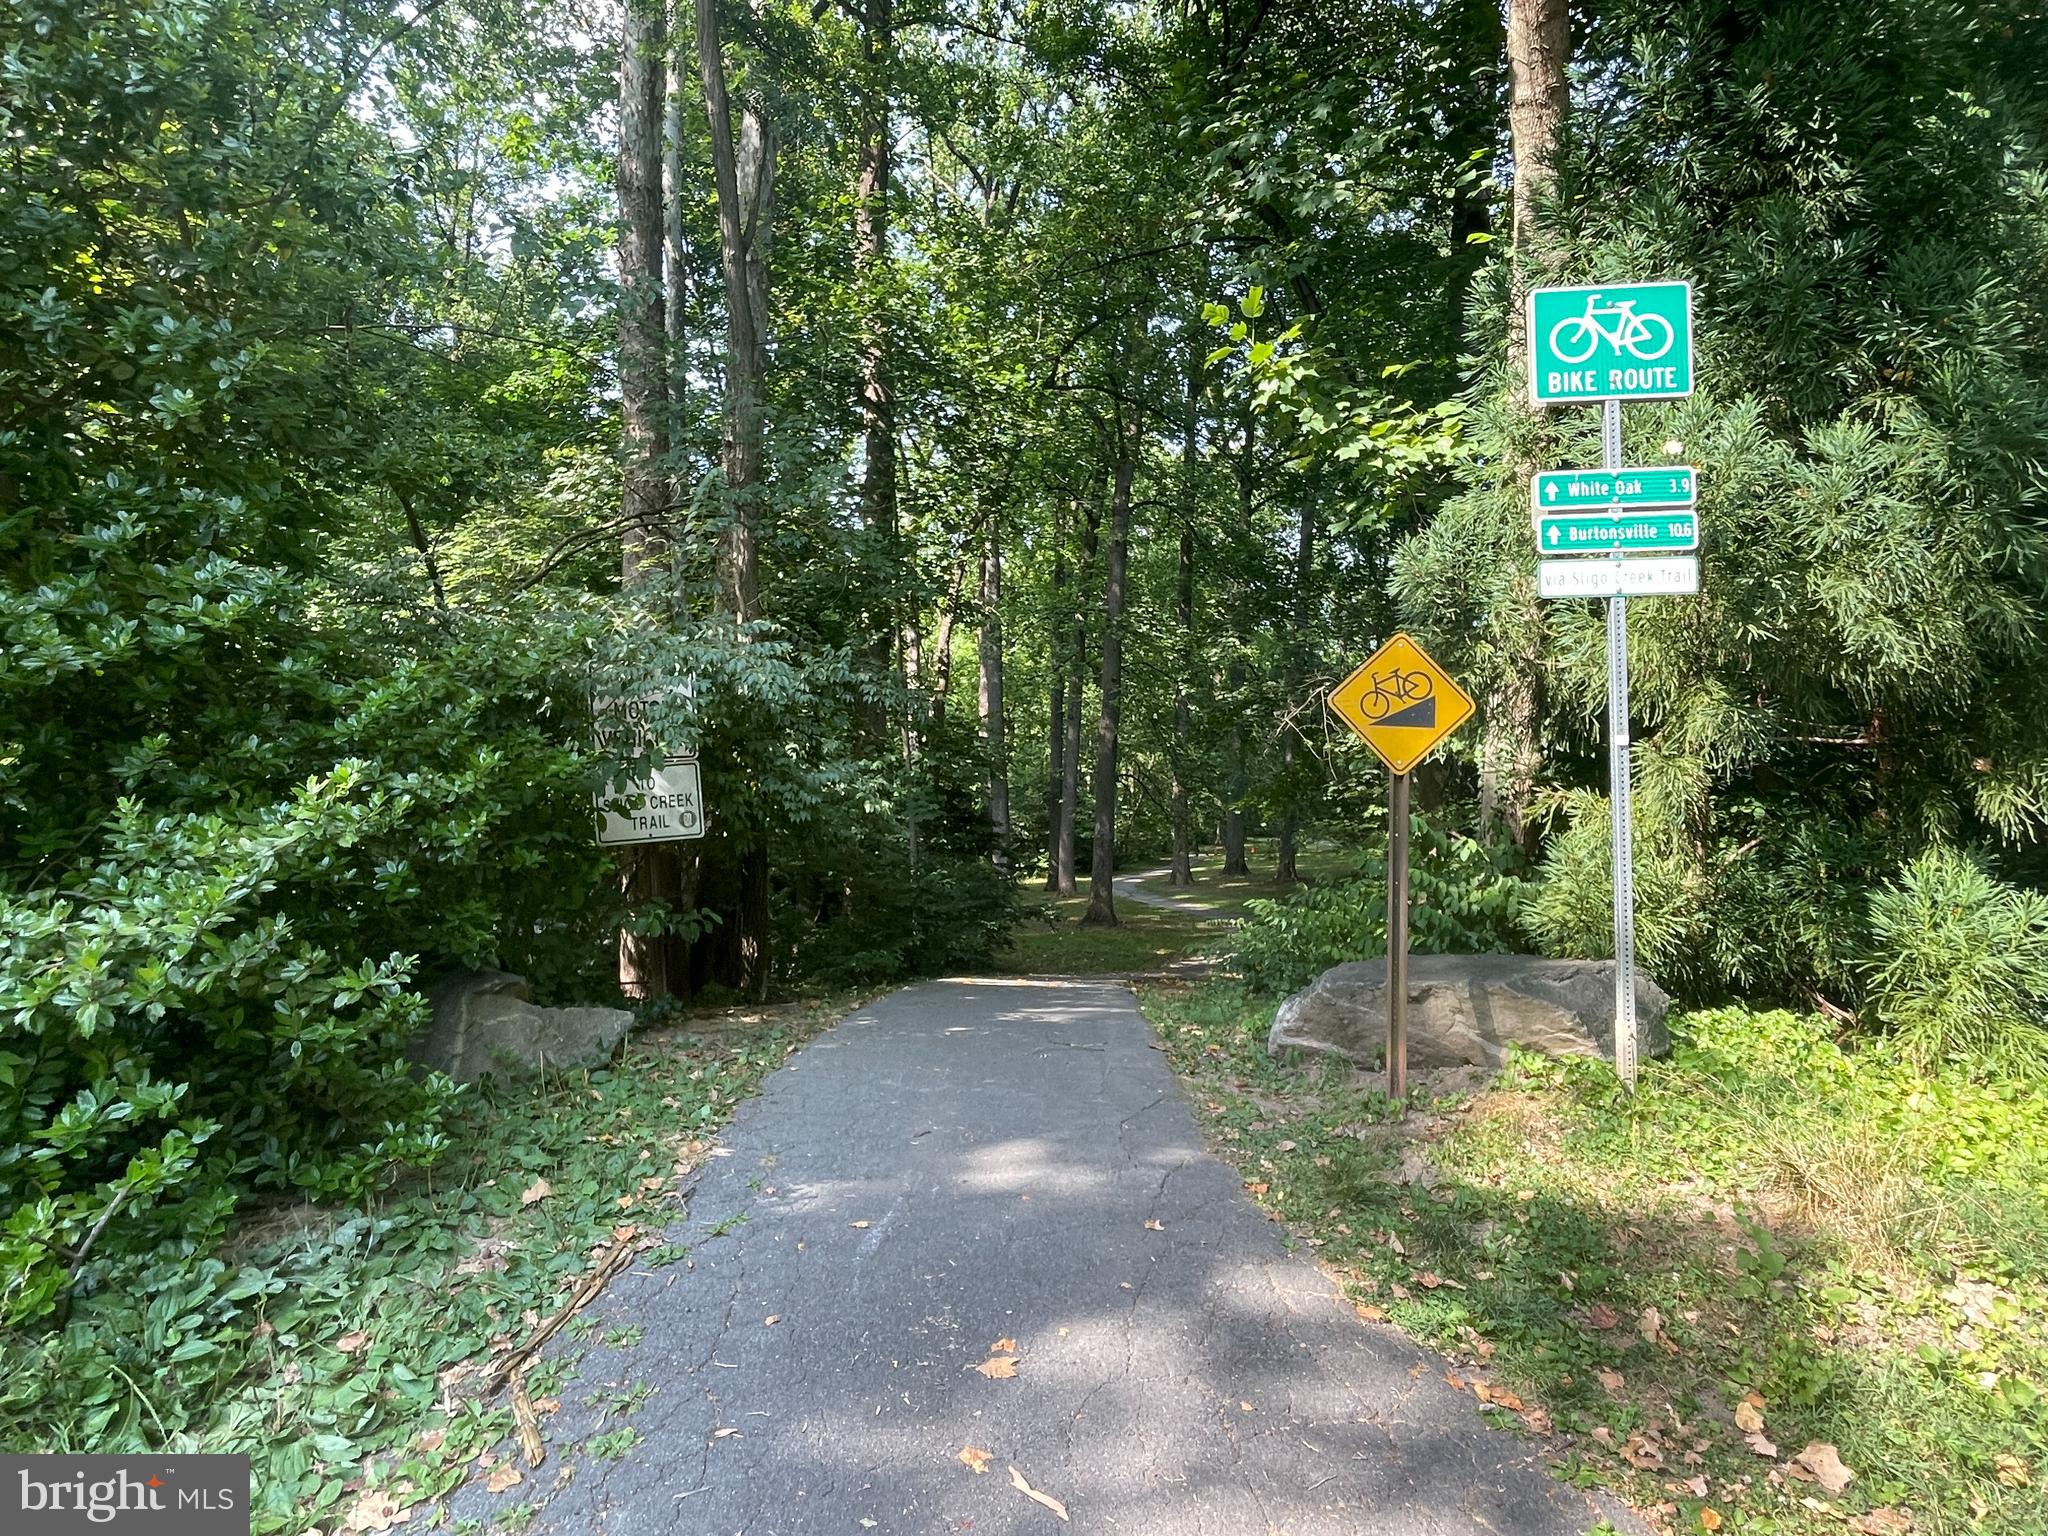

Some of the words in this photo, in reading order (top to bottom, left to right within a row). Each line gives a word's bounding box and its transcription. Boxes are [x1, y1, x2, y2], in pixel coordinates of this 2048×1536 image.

[1548, 370, 1598, 394] BIKE
[1609, 367, 1678, 391] ROUTE
[1568, 481, 1609, 497] White
[1615, 479, 1642, 496] Oak
[1669, 478, 1690, 493] 3.9
[1569, 524, 1658, 541] Burtonsville
[1545, 573, 1565, 587] via
[1572, 571, 1607, 589] Sligo
[1615, 571, 1653, 585] Creek
[1661, 568, 1693, 582] Trail
[650, 793, 694, 810] CREEK
[631, 814, 671, 831] TRAIL
